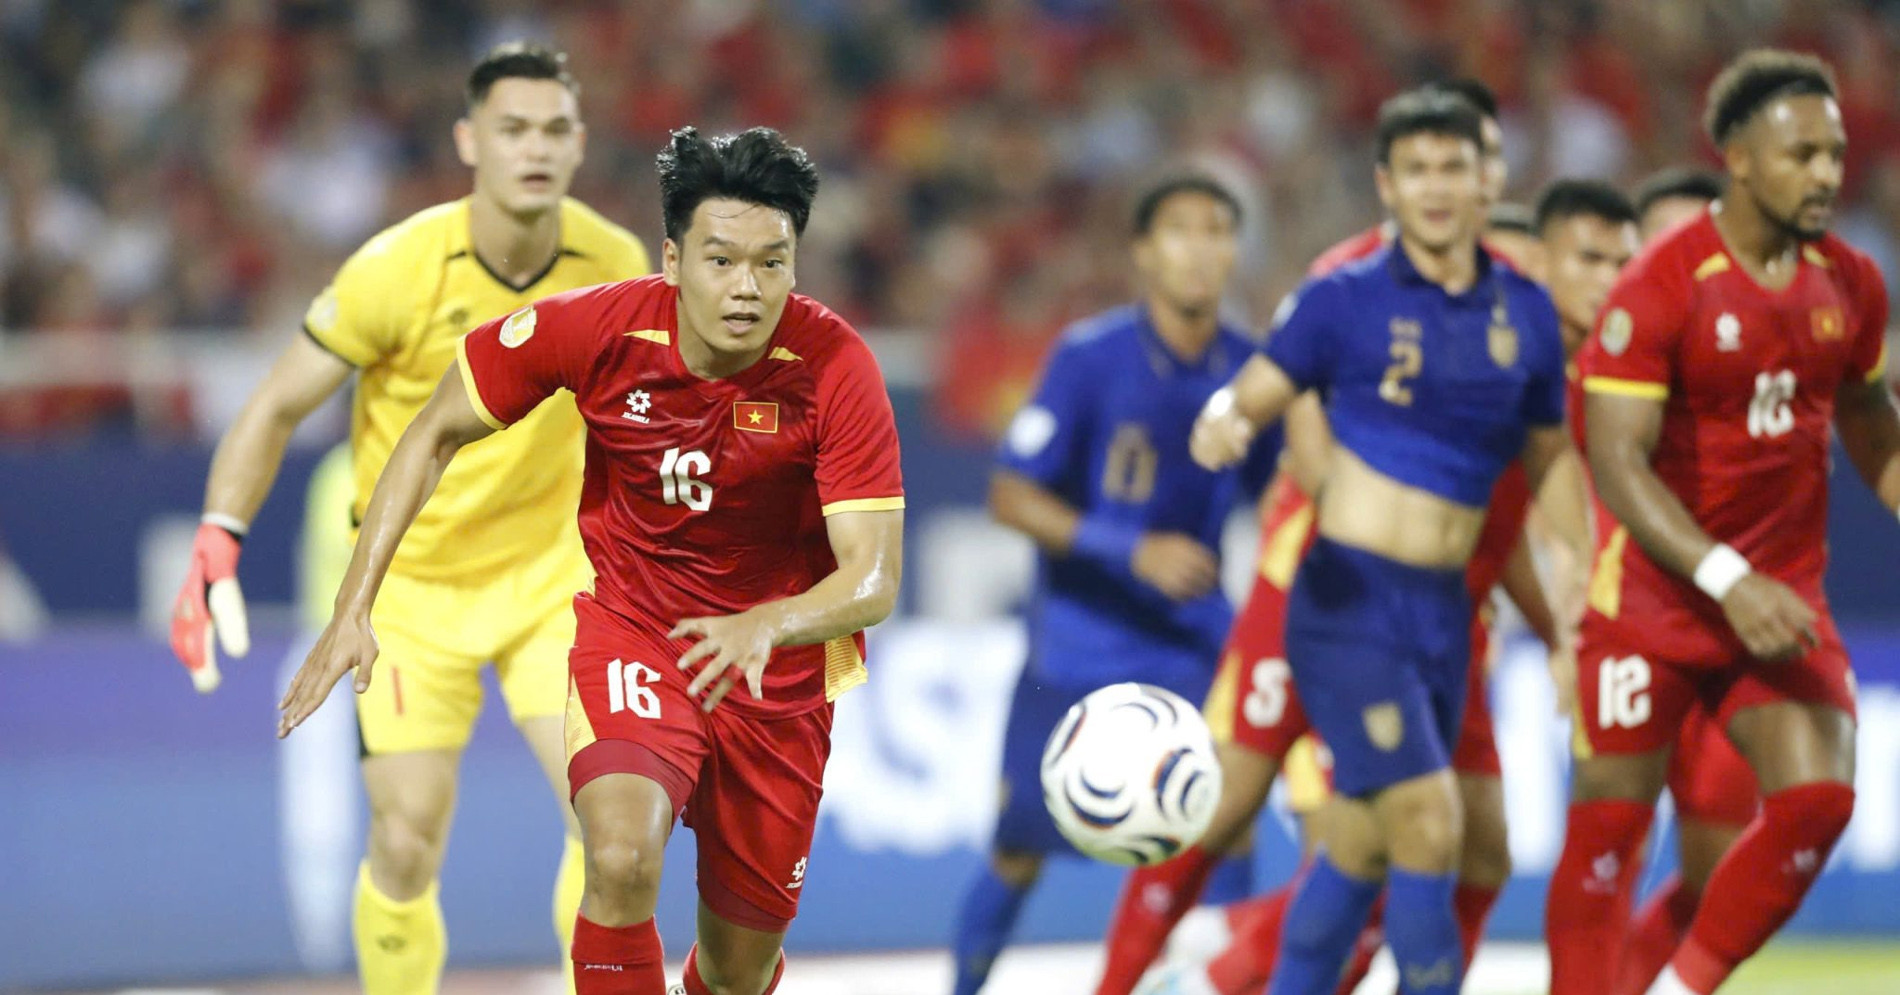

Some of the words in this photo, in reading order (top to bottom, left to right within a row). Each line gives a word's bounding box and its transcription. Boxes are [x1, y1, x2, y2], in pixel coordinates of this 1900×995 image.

[1379, 341, 1423, 406] 2
[659, 447, 713, 512] 16
[607, 658, 661, 719] 16
[1599, 654, 1651, 729] 12
